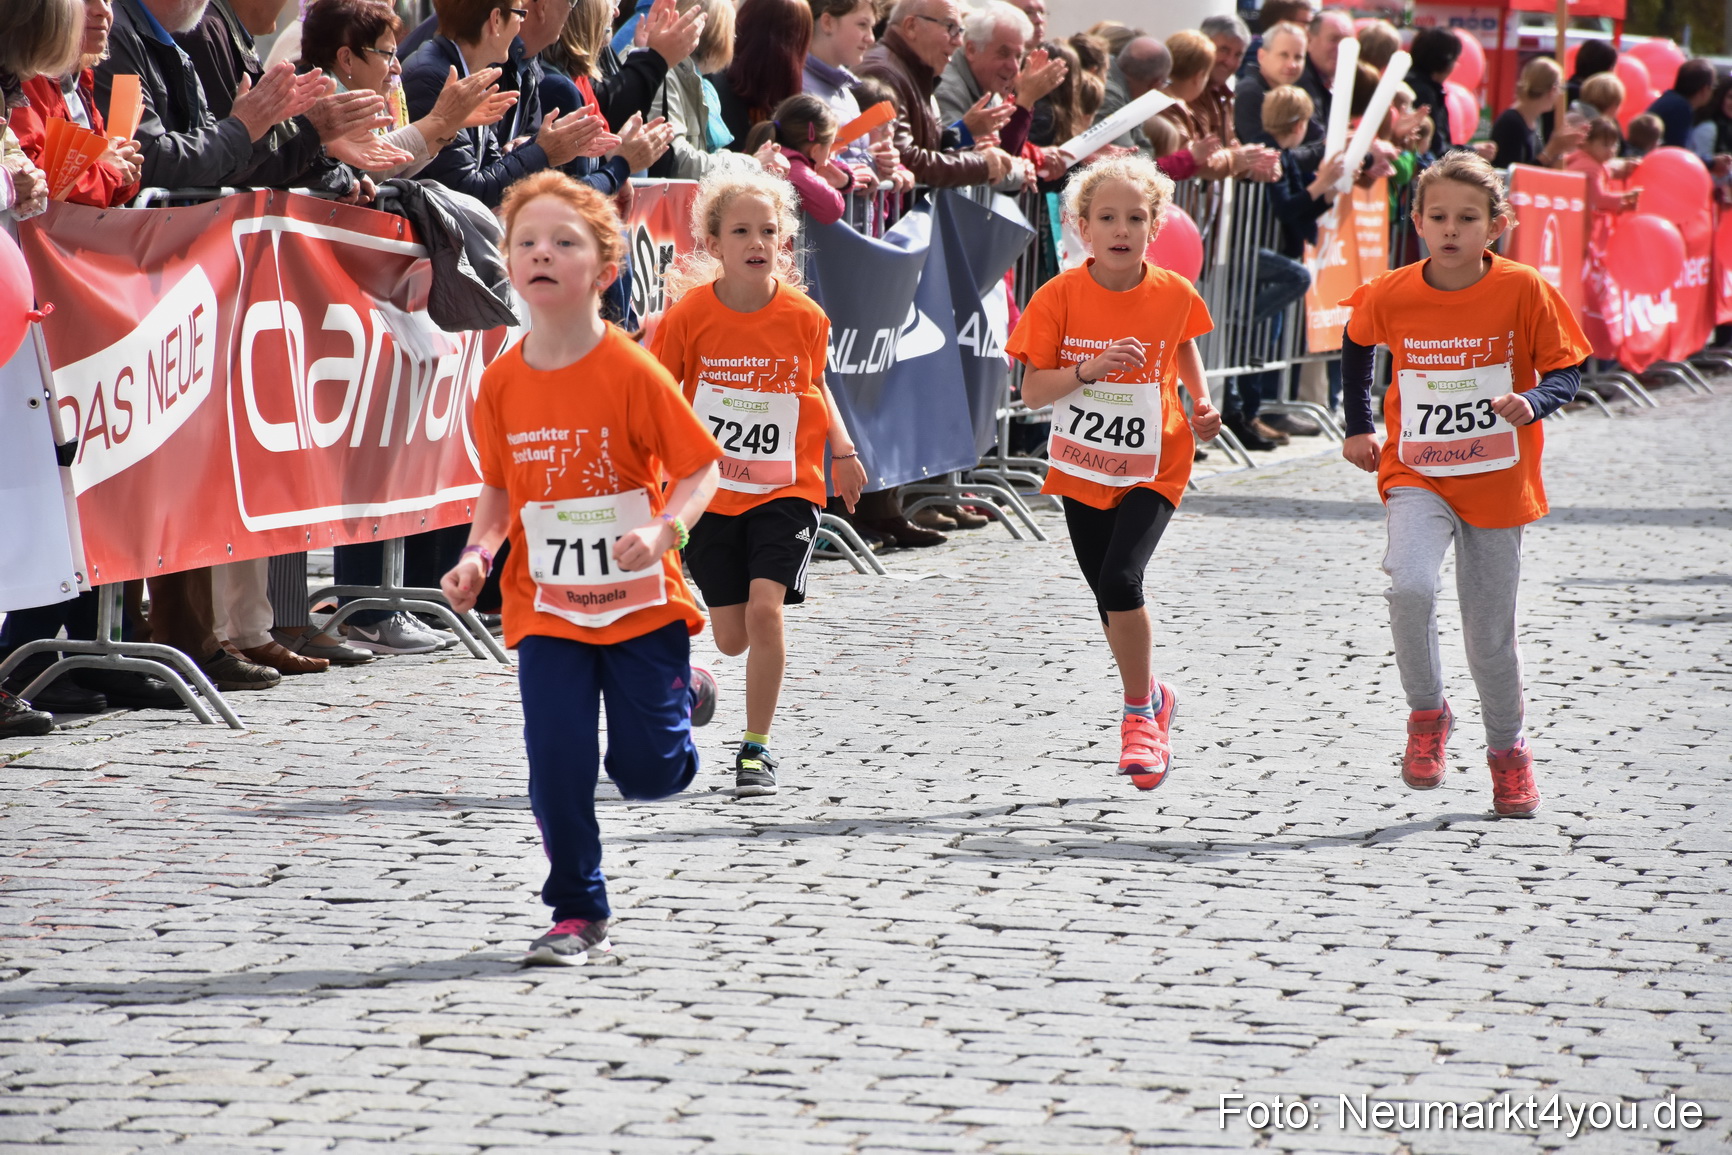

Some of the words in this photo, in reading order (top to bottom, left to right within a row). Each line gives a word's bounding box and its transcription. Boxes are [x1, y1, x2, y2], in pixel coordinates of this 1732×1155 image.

[1404, 337, 1482, 350] Neumarkter
[700, 355, 771, 367] Neumarkter
[1407, 352, 1467, 367] Stadtlauf
[57, 364, 134, 465] DAS
[147, 302, 204, 425] NEUE
[1438, 378, 1478, 390] BOCK
[733, 398, 769, 411] BOCK
[1094, 390, 1134, 403] BOCK
[1416, 398, 1498, 436] 7253
[708, 415, 780, 455] 7249
[1068, 404, 1146, 449] 7248
[1062, 445, 1128, 475] FRANCA
[1414, 439, 1488, 465] Anouk
[570, 508, 616, 522] BOCK
[547, 536, 632, 576] 711
[566, 589, 627, 607] Raphaela
